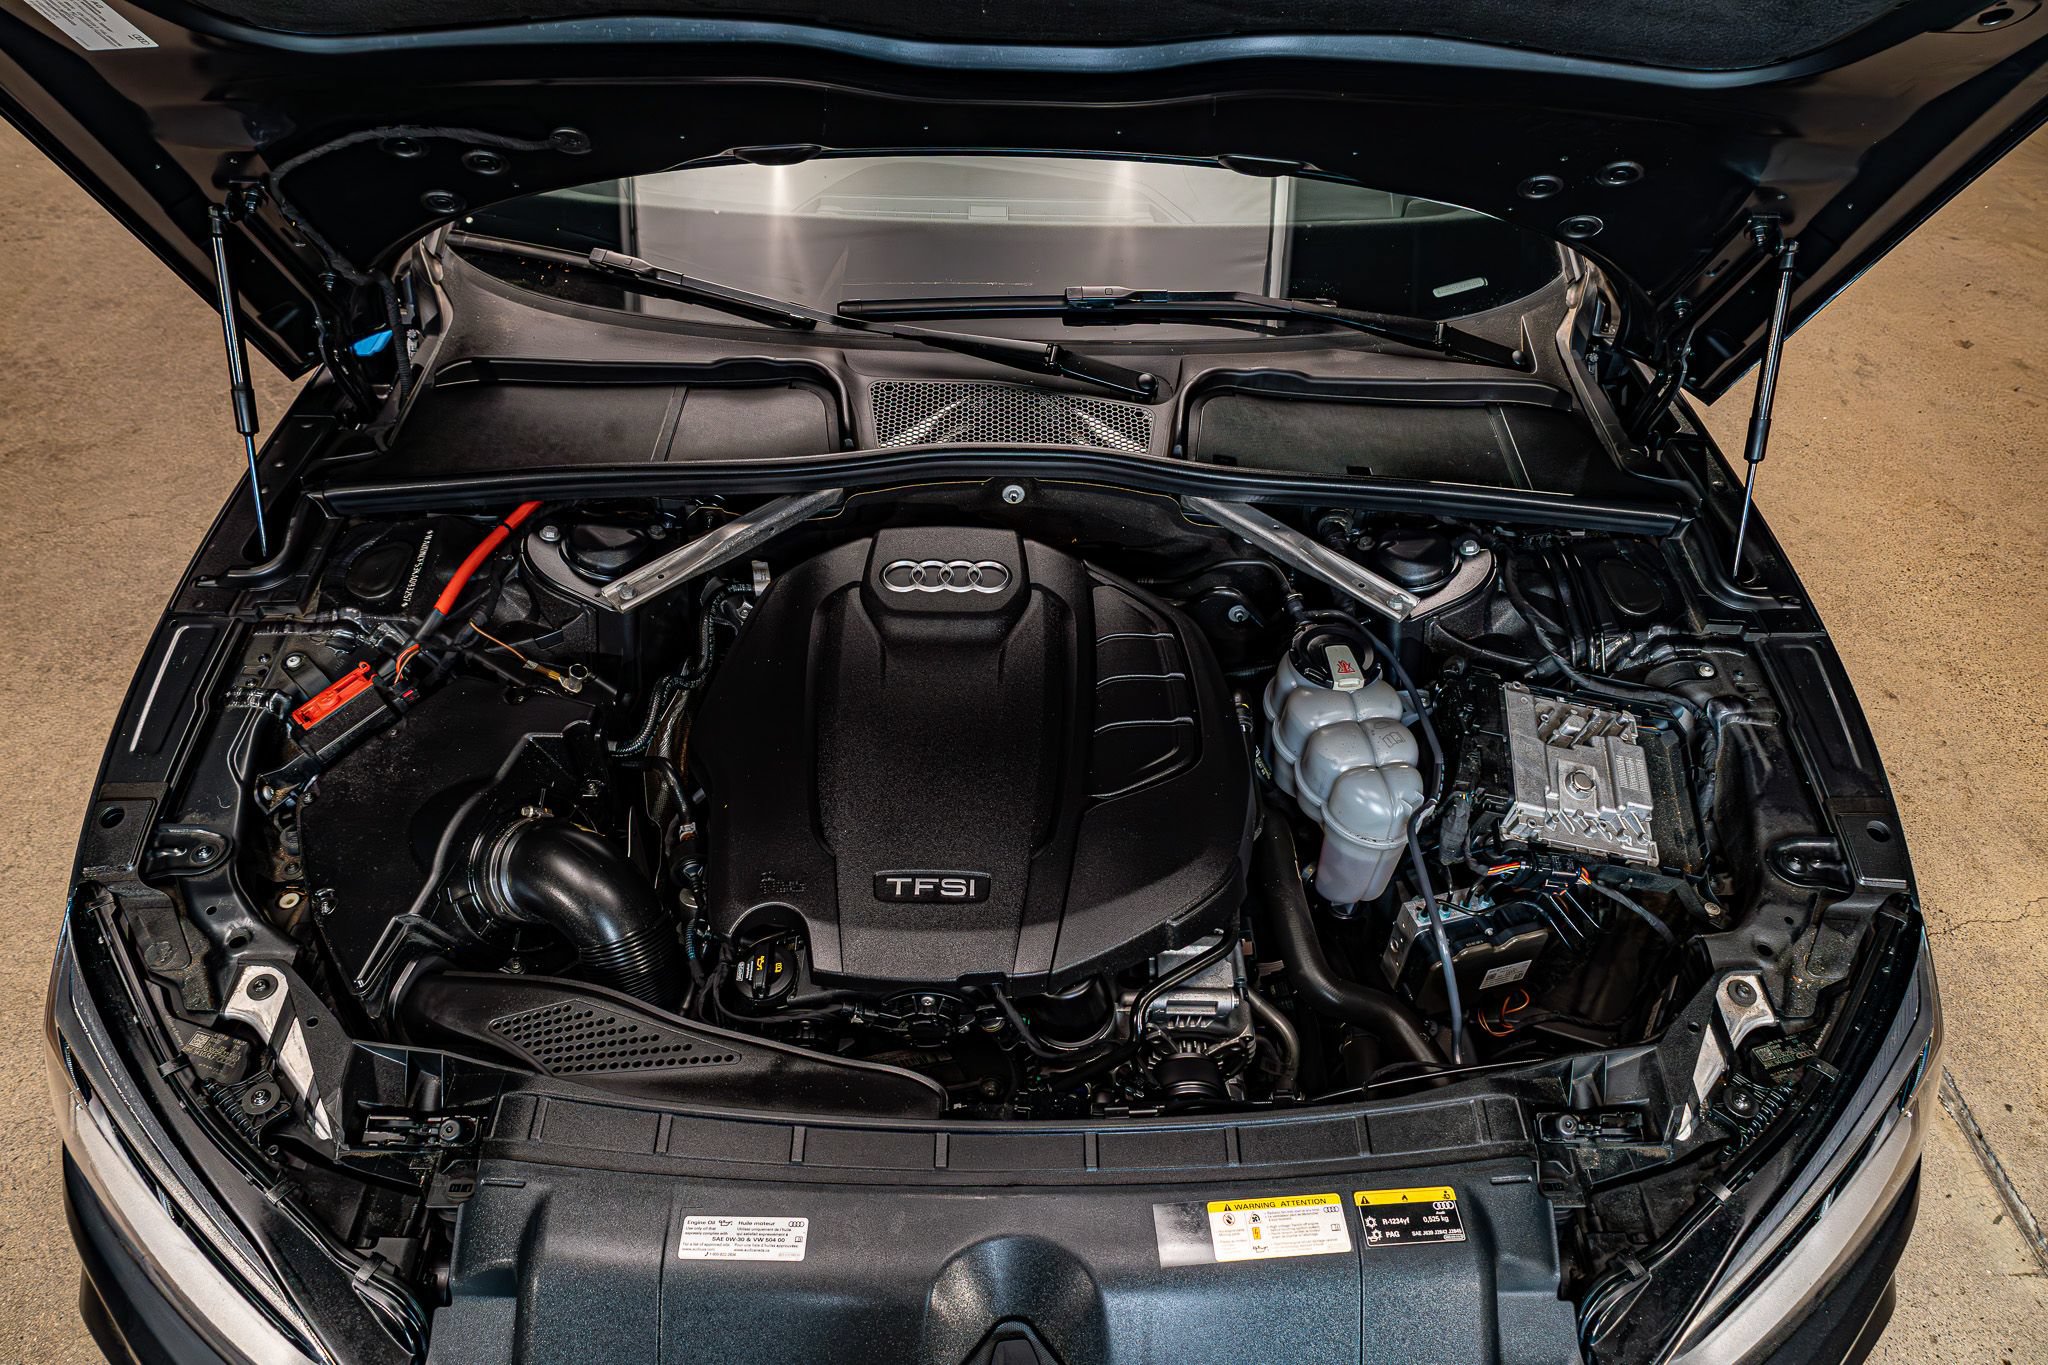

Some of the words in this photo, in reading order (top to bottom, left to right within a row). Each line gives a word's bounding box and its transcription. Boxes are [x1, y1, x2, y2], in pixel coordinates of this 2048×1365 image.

[886, 878, 975, 897] TFSI
[1234, 1201, 1276, 1210] WARNING
[1280, 1198, 1327, 1207] ATTENTION
[1382, 1216, 1410, 1225] R-1234yf
[1440, 1215, 1450, 1223] kg
